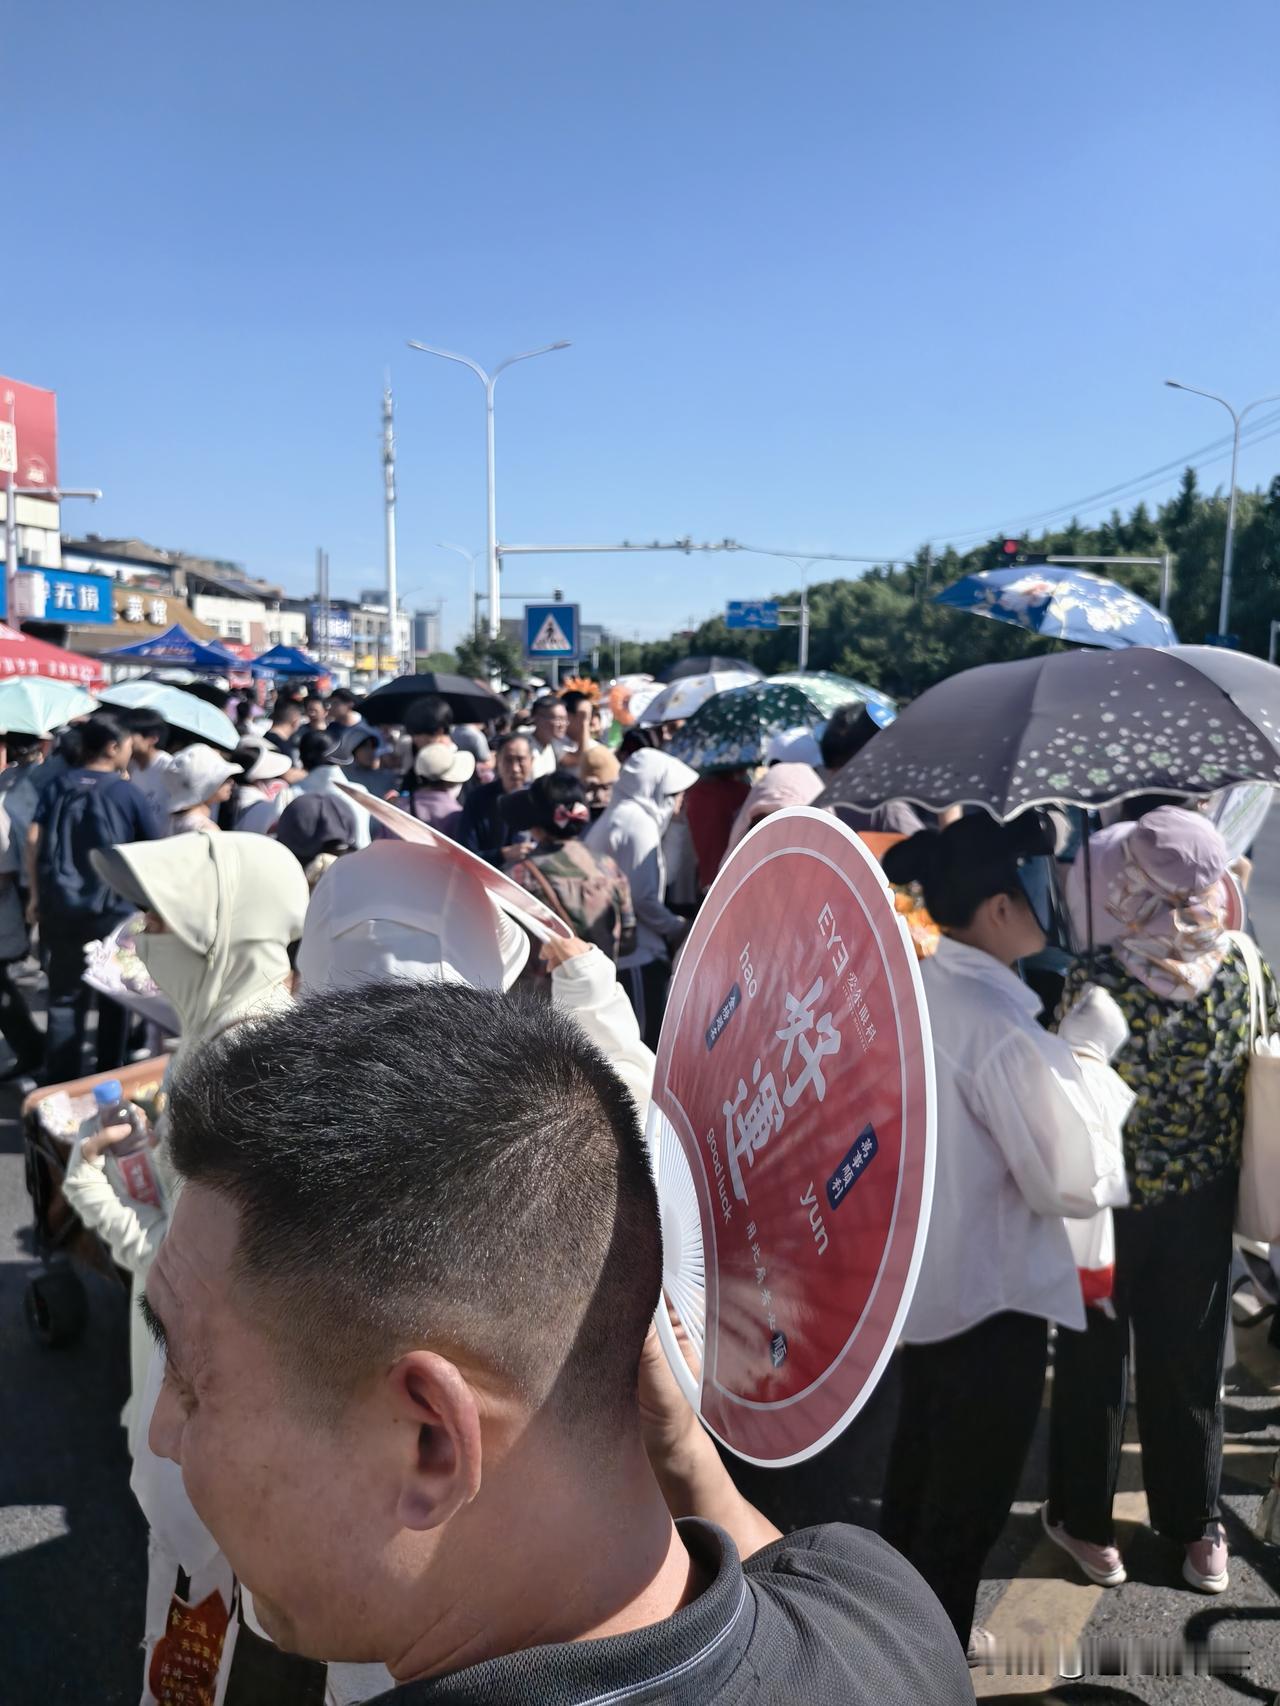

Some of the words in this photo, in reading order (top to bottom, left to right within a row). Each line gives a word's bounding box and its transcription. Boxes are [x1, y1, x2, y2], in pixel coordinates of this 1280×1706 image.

[739, 941, 757, 998] hao
[847, 971, 877, 1044] 爱尔眼科
[706, 1127, 724, 1177] good
[717, 1174, 733, 1225] luck
[800, 1180, 829, 1256] yun
